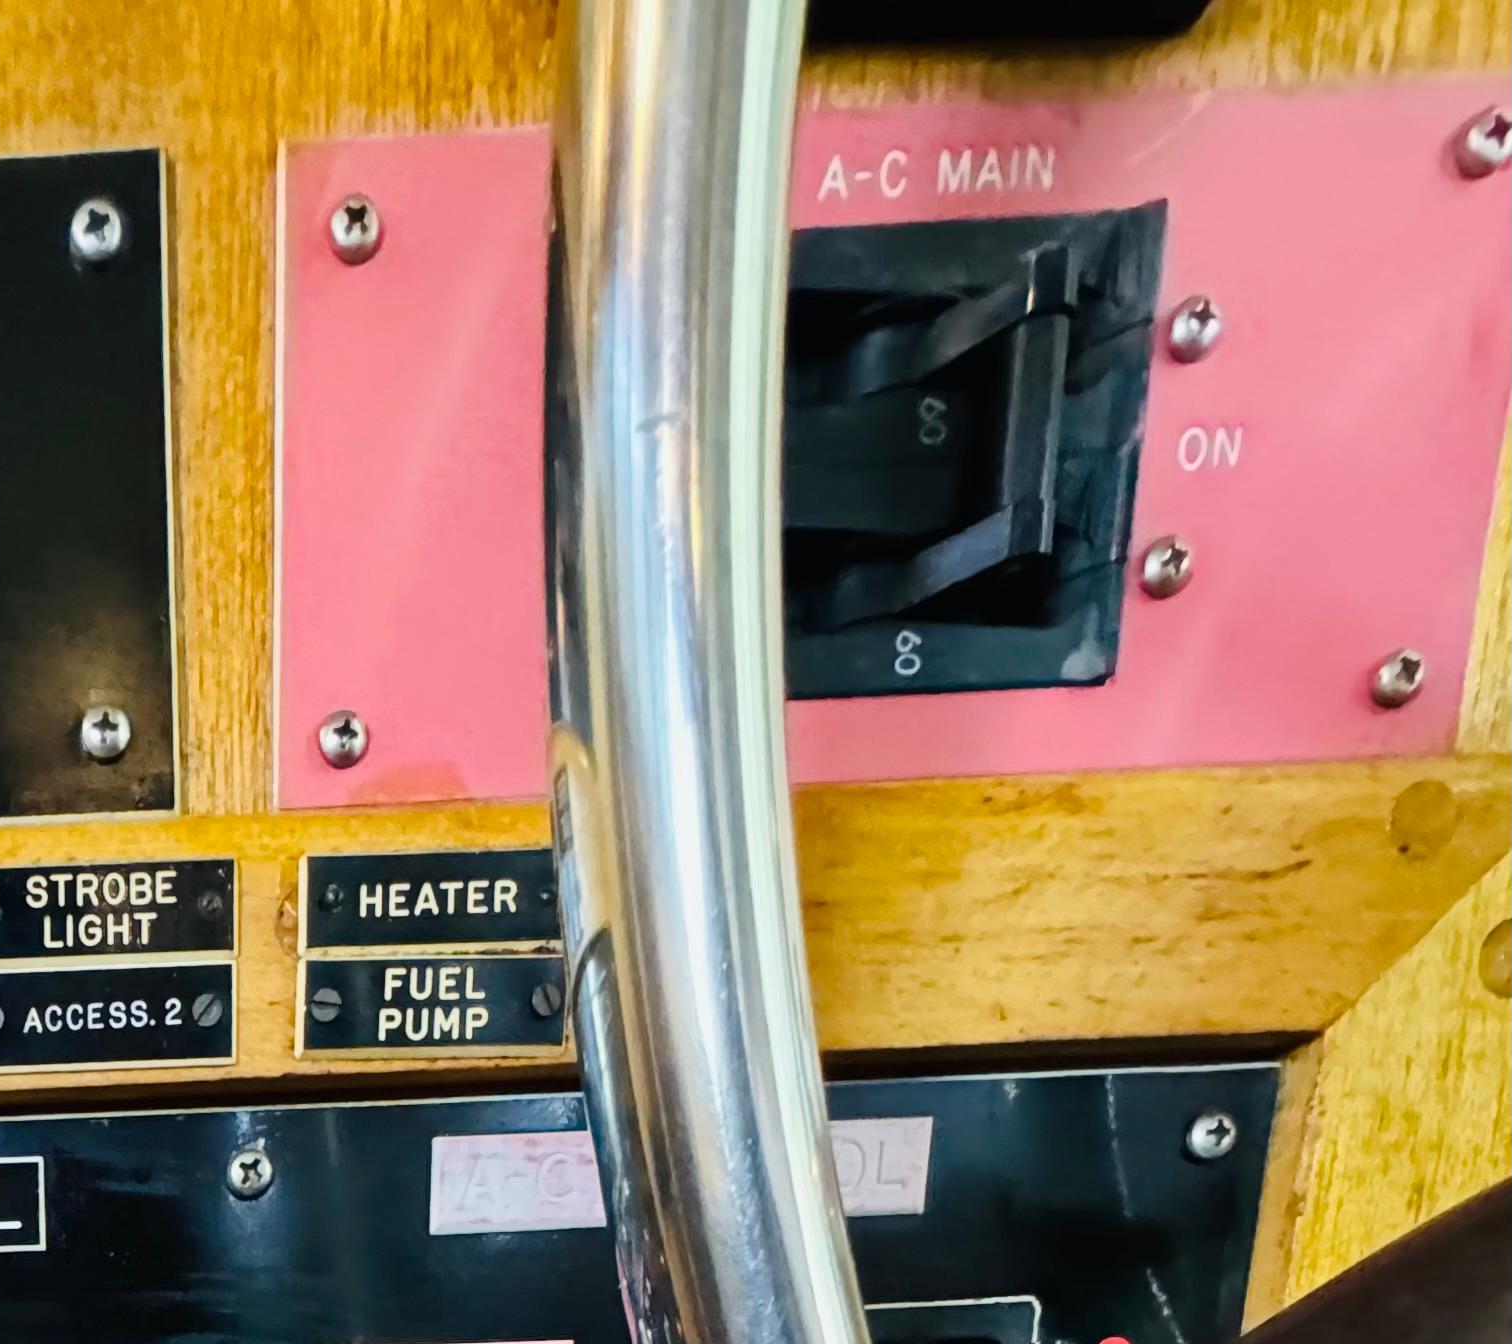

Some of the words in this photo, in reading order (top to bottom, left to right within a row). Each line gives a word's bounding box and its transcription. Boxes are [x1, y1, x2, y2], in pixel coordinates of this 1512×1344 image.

[818, 149, 909, 199] A-C
[937, 143, 1056, 194] MAIN
[1178, 427, 1244, 472] ON
[893, 630, 922, 677] 60
[25, 870, 178, 910] STROBE
[358, 879, 519, 919] HEATER
[42, 911, 159, 950] LIGHT
[382, 966, 486, 1004] FUEL
[22, 1001, 156, 1035] ACCESS.
[163, 998, 184, 1027] 2
[377, 1006, 490, 1043] PUMP
